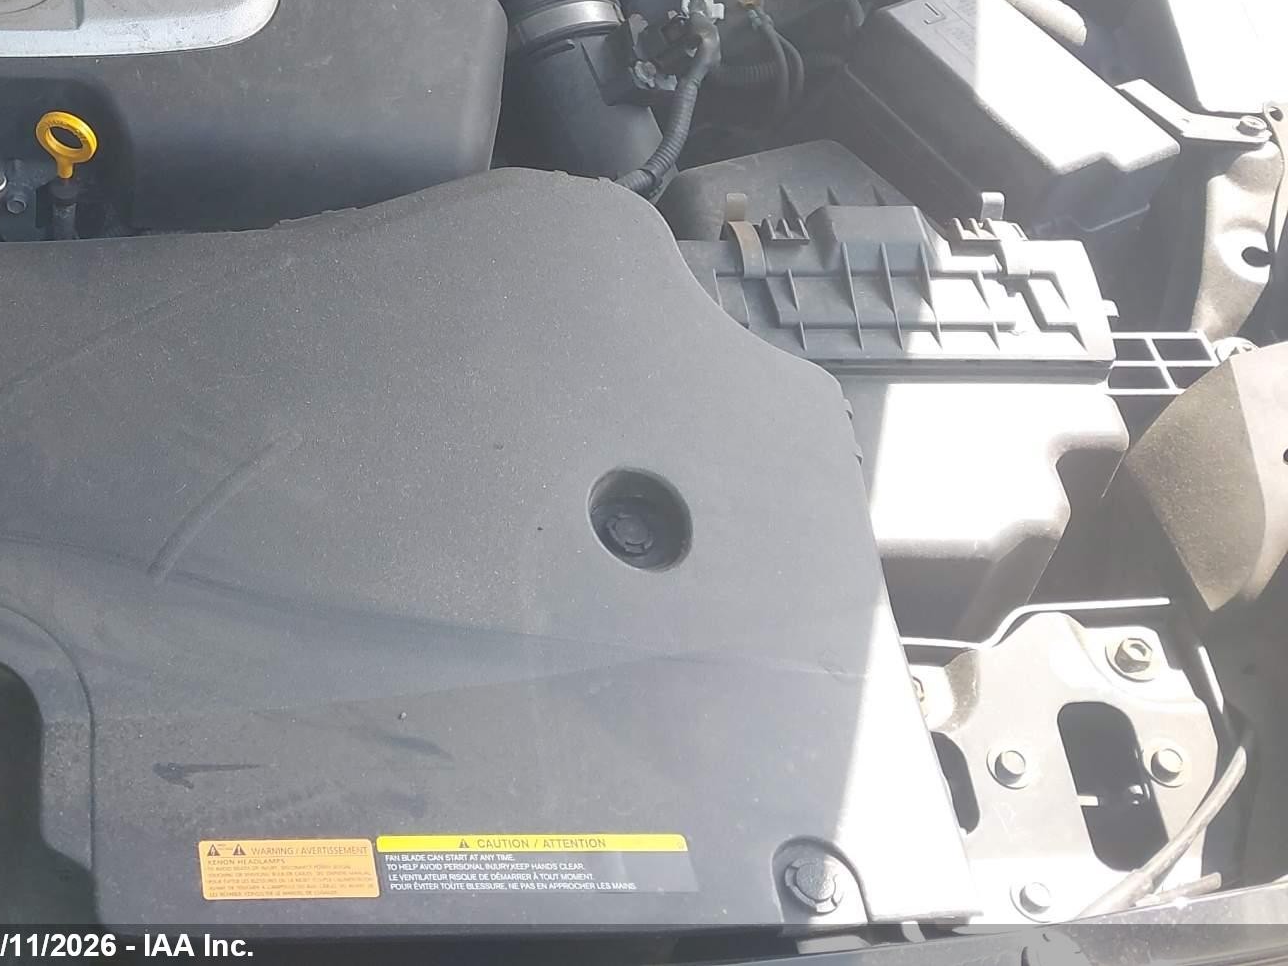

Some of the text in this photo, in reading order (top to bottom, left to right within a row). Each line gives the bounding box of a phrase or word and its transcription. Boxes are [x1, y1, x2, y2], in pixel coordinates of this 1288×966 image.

[476, 838, 530, 849] CAUTION
[543, 837, 607, 849] ATTENTION
[250, 846, 294, 855] WARNING
[301, 845, 369, 855] AVERTISSEMENT
[384, 854, 400, 862] FAN
[401, 854, 426, 862] BLADE
[427, 854, 444, 862] CAN
[445, 853, 468, 862] START
[469, 853, 478, 862] AT
[479, 853, 495, 862] ANY
[386, 863, 398, 871] TO
[398, 863, 418, 871] HELP
[419, 863, 443, 871] AVOID
[443, 863, 484, 871] PERSONAL
[531, 862, 558, 871] HANDS
[388, 873, 399, 881] LE
[399, 873, 448, 881] VENTILATEUR
[449, 872, 477, 881] RISQUE
[478, 872, 489, 881] DE
[490, 871, 532, 881] DÉMARRER
[540, 872, 559, 881] TOUT
[390, 883, 412, 891] POUR
[441, 882, 466, 891] TOUTE
[466, 882, 508, 891] BLESSURE,
[508, 882, 521, 891] NE
[521, 882, 535, 891] PAS
[536, 882, 547, 891] EN
[548, 882, 596, 891] APPROCHER
[596, 882, 612, 891] LES
